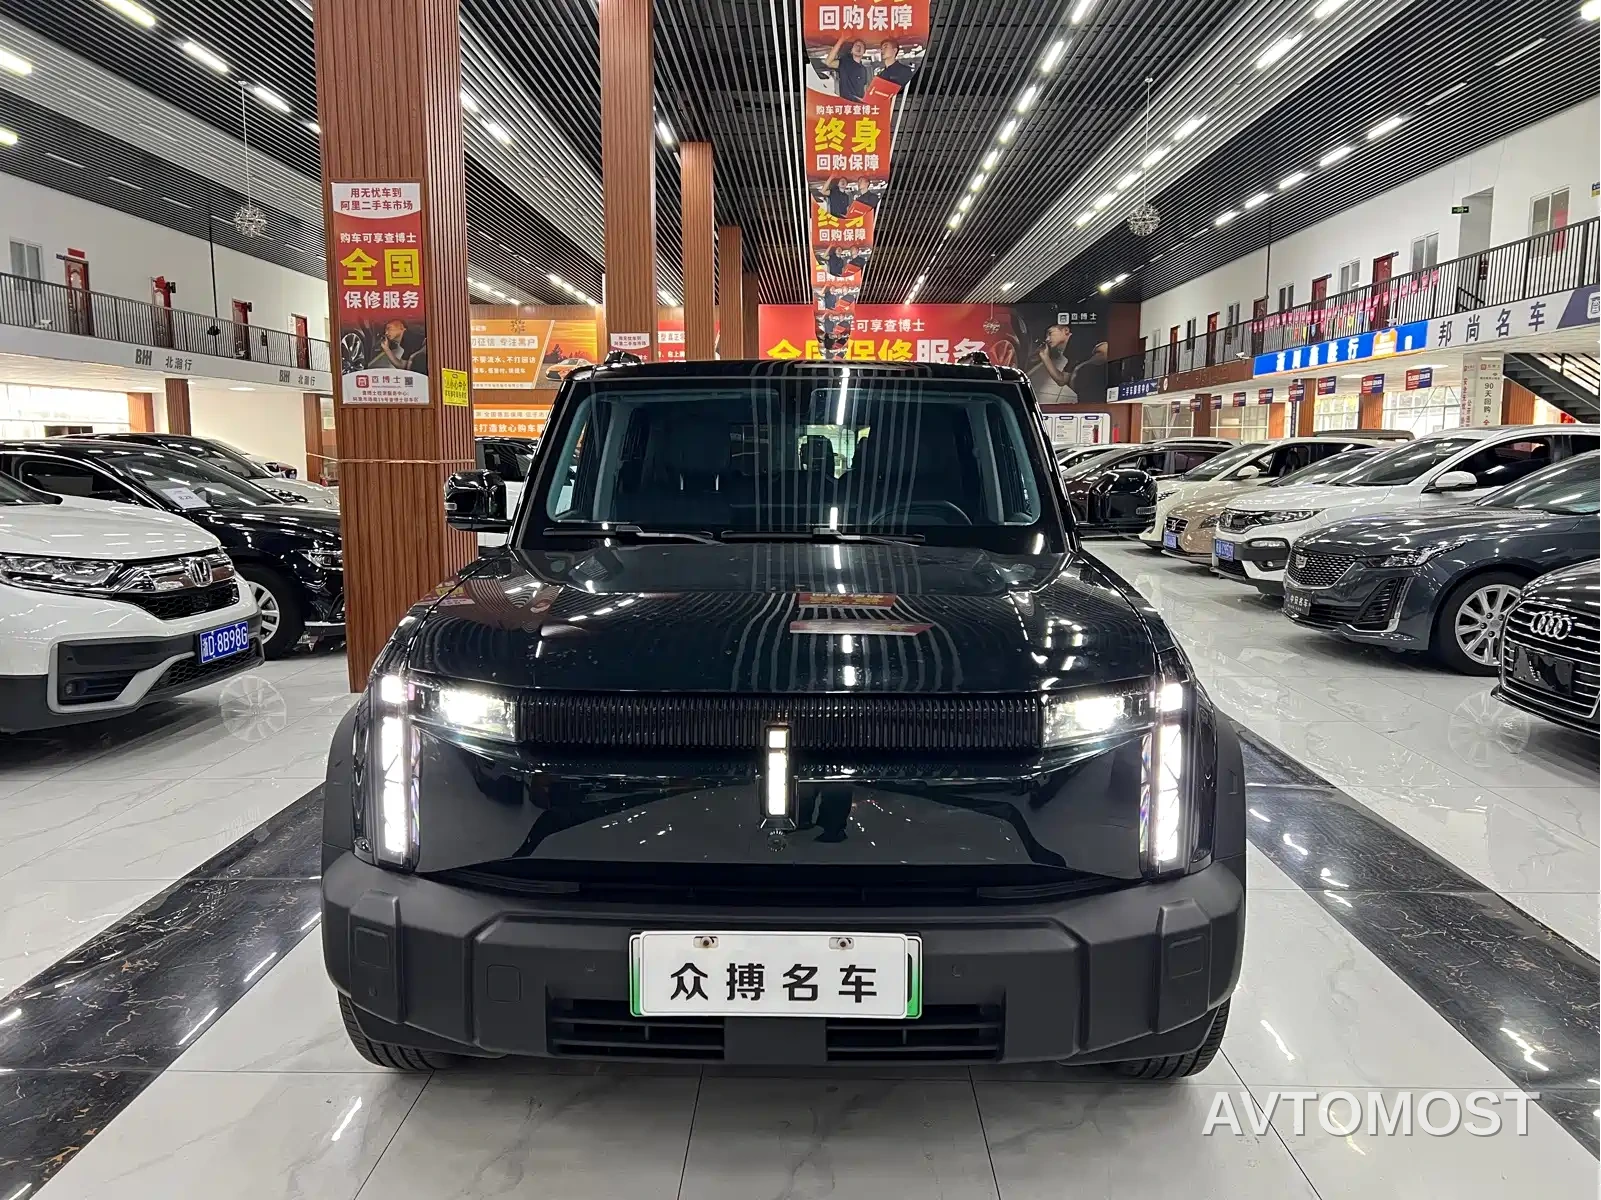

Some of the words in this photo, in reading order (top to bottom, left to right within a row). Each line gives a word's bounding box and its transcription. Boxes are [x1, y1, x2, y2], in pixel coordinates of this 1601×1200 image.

[819, 4, 913, 31] 回购保障
[816, 105, 880, 115] 购车可享查博士
[815, 117, 881, 153] 终身
[816, 154, 880, 171] 回购保障
[350, 188, 402, 198] 用无忧车到
[340, 200, 413, 211] 阿里二手车市场
[340, 233, 417, 244] 购车可享查博士
[819, 229, 866, 242] 回购保障
[340, 248, 421, 287] 全国
[344, 290, 419, 309] 保修服务
[850, 318, 926, 333] 可享查博士
[1438, 301, 1547, 347] 邦尚名车
[670, 962, 878, 1004] 众搏名车
